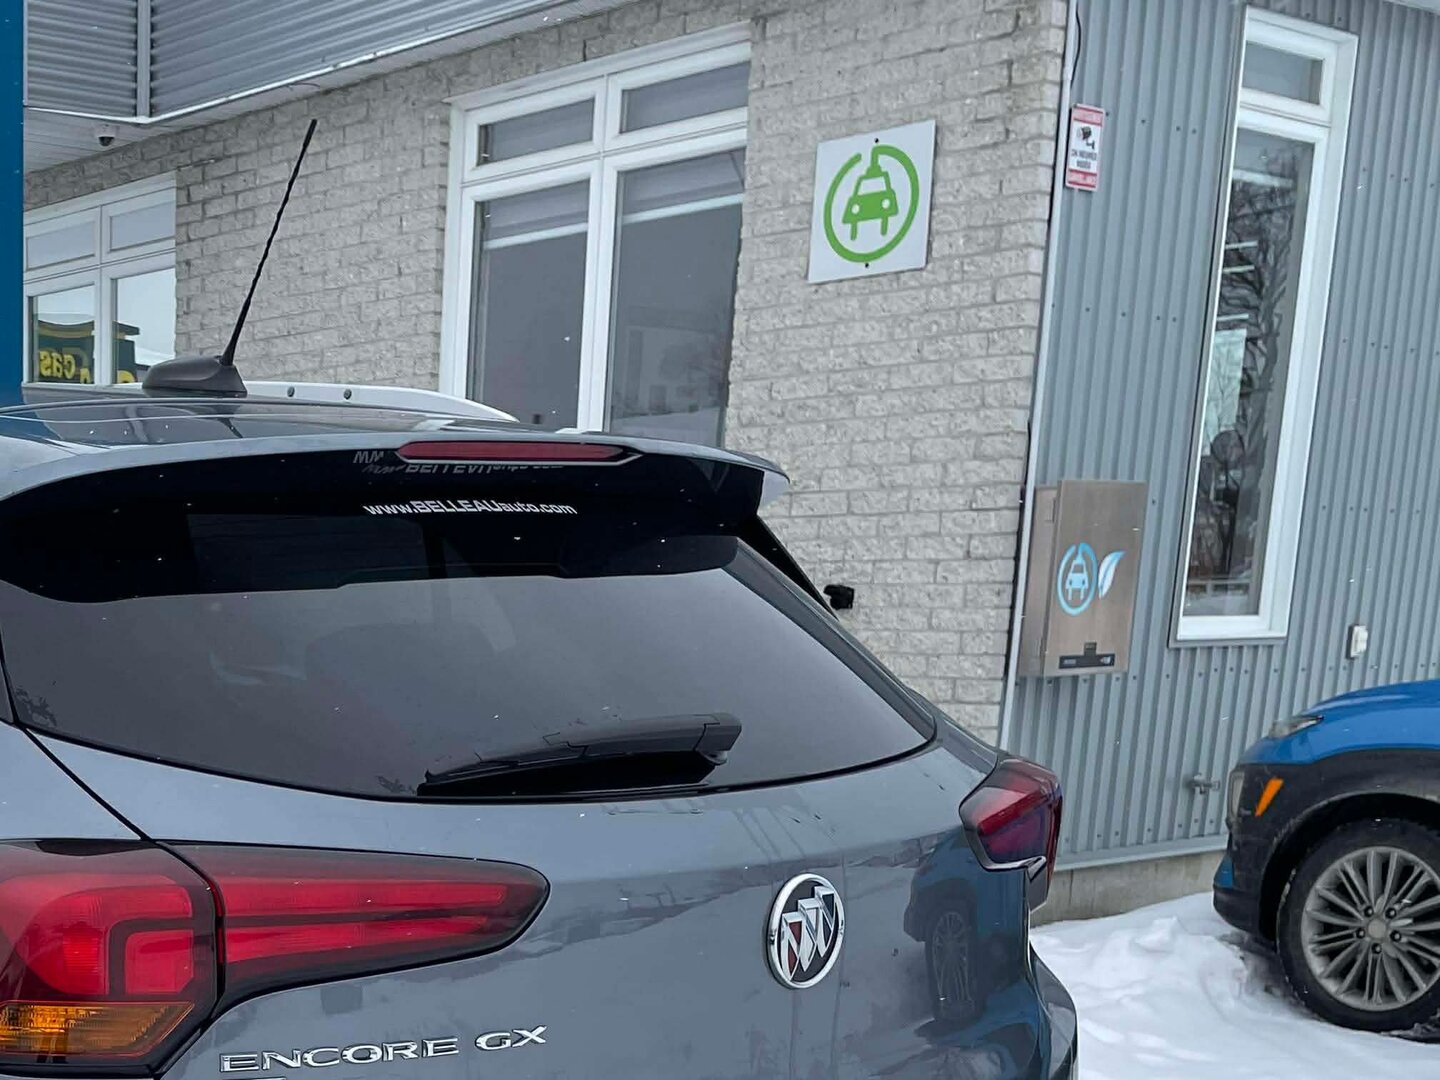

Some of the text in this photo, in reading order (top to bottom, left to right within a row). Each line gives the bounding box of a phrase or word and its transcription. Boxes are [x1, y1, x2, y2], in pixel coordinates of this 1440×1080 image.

[362, 499, 578, 515] www.BELLEAUauto.com
[219, 1024, 548, 1073] ENCORE GX
